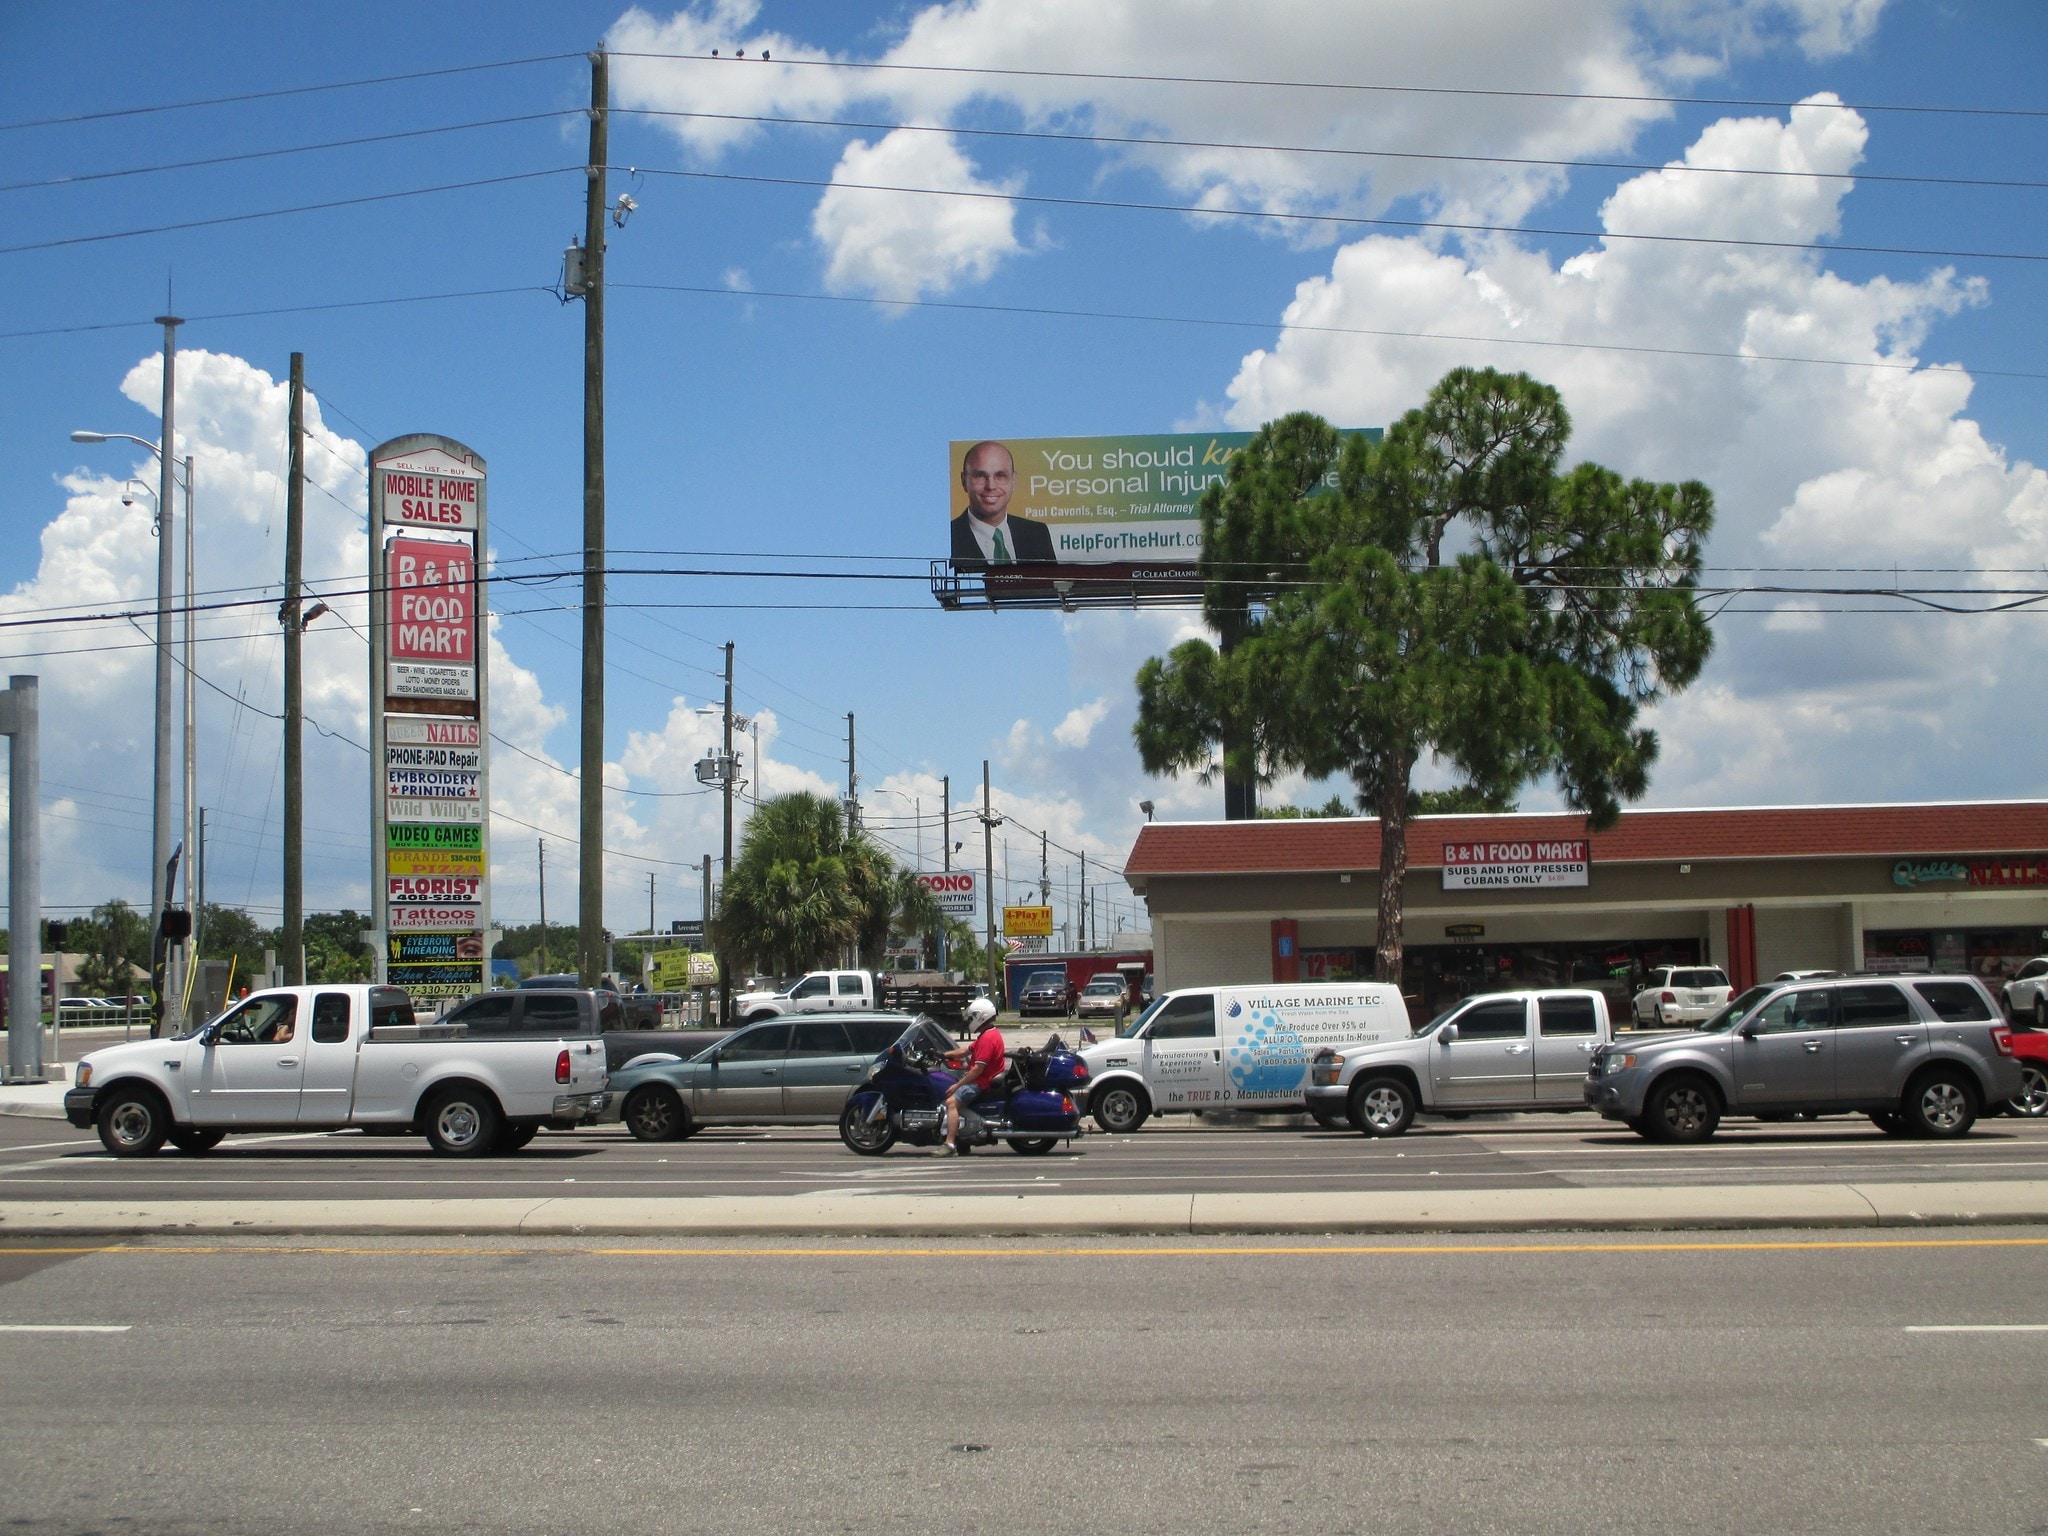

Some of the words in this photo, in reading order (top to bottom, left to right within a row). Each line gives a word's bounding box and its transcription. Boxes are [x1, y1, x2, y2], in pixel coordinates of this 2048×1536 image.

[1042, 450, 1093, 471] You
[1103, 445, 1193, 469] should
[1202, 438, 1243, 466] kn
[397, 462, 414, 470] SELL
[387, 474, 434, 498] MOBILE
[439, 480, 475, 503] HOME
[1030, 471, 1148, 496] Personal
[1160, 470, 1232, 497] Injury
[401, 499, 462, 524] SALES
[1025, 506, 1048, 518] Paul
[1096, 504, 1118, 517] Esq.
[1129, 503, 1151, 514] Trial
[1152, 502, 1195, 516] Attorney
[400, 555, 418, 589] B
[422, 560, 442, 589] &
[448, 559, 466, 594] N
[402, 594, 464, 624] FOOD
[399, 624, 467, 654] MART
[429, 667, 457, 677] CIGARETTES
[405, 676, 420, 684] LOTTO
[423, 677, 440, 685] MONEY
[441, 678, 460, 686] ORDERS
[397, 685, 412, 693] FRESH
[413, 686, 442, 695] SANDWICHES
[443, 687, 456, 695] MADE
[457, 688, 469, 696] DAILY
[427, 723, 478, 744] NAILS
[449, 750, 478, 769] Repair
[389, 771, 477, 785] EMBROIDERY
[401, 785, 466, 797] PRINTING
[389, 800, 422, 816] Wild
[430, 802, 480, 821] Willy's
[390, 827, 430, 841] VIDEO
[435, 827, 479, 843] GAMES
[393, 852, 449, 862] GRANDE
[1445, 845, 1456, 862] B
[1459, 846, 1470, 860] &
[1473, 844, 1485, 861] N
[1489, 843, 1532, 861] FOOD
[1536, 842, 1584, 860] MART
[412, 864, 480, 874] PIZZA
[1448, 866, 1477, 875] SUBS
[1481, 865, 1504, 874] AND
[1507, 865, 1530, 874] HOT
[1533, 864, 1584, 873] PRESSED
[1969, 859, 2048, 886] NAILS
[1464, 876, 1510, 885] CUBANS
[1513, 875, 1542, 884] ONLY
[390, 878, 479, 895] FLORIST
[392, 908, 476, 920] Tattoos
[1006, 910, 1038, 919] 4-Play
[407, 937, 451, 946] EYEBROW
[402, 946, 456, 955] THREADING
[393, 967, 424, 980] Show
[400, 985, 471, 995] 27-330-7729
[1248, 999, 1300, 1009] VILLAGE
[1304, 997, 1354, 1007] MARINE
[1275, 1024, 1286, 1032] We
[1288, 1023, 1319, 1031] Produce
[1321, 1022, 1339, 1030] Over
[1341, 1021, 1356, 1029] 95%
[1359, 1021, 1366, 1029] of
[1263, 1036, 1277, 1044] ALL
[1298, 1034, 1344, 1044] Components
[1346, 1033, 1379, 1041] In-House
[1152, 1052, 1209, 1060] Manufacturing
[1169, 1092, 1184, 1102] the
[1187, 1091, 1211, 1101] TRUE
[1237, 1089, 1302, 1100] Manufacturer
